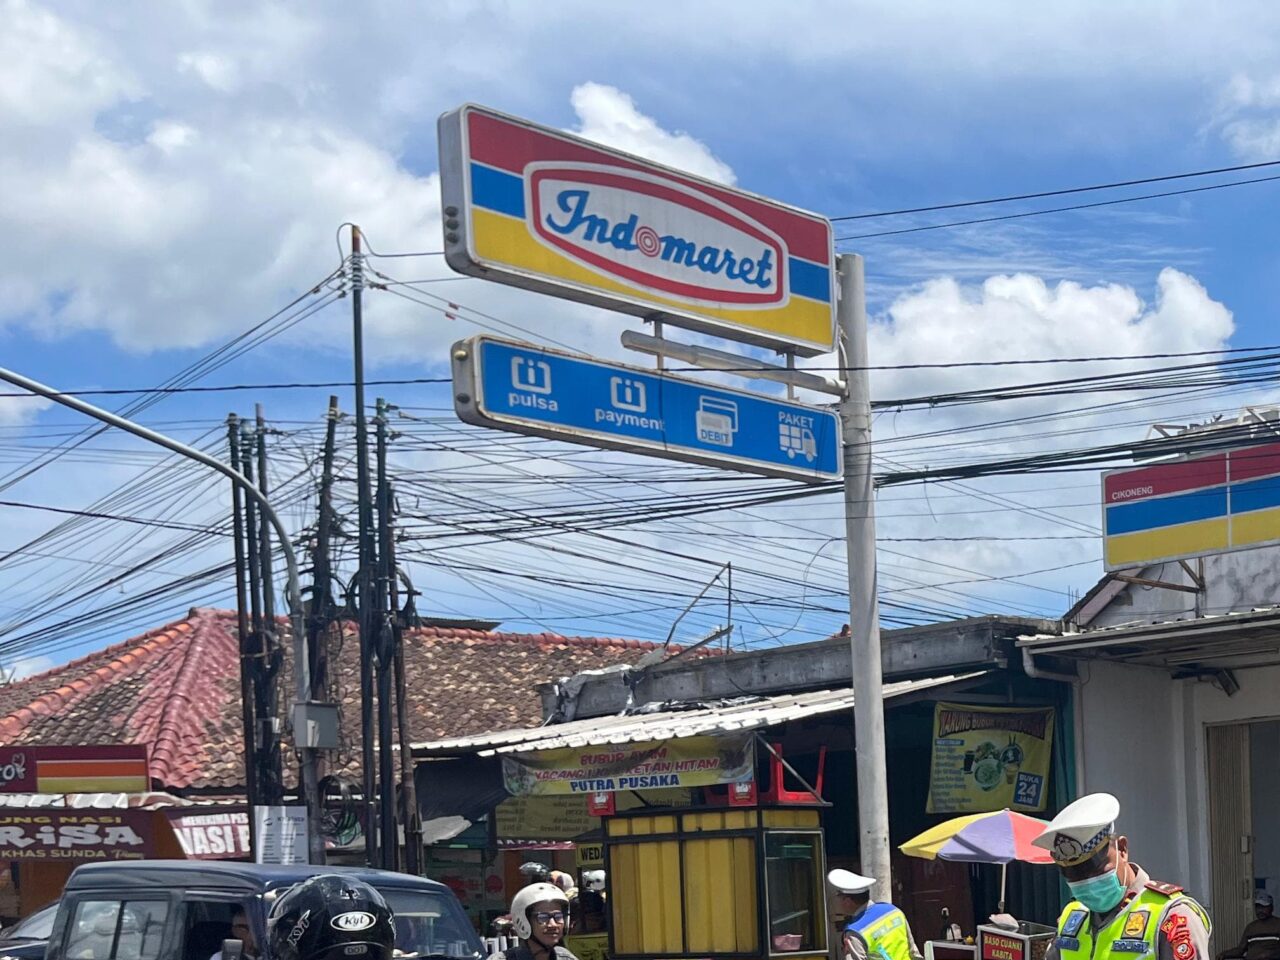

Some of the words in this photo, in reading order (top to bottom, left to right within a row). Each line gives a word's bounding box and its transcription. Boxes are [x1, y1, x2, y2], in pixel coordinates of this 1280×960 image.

[546, 190, 772, 289] Indomaret
[508, 392, 558, 412] pulsa
[595, 407, 665, 431] payment
[778, 411, 815, 428] PAKET
[700, 429, 730, 444] DEBIT
[1112, 486, 1153, 500] CIKONENG
[676, 758, 720, 772] HITAM
[570, 778, 616, 792] PUTRA
[619, 774, 680, 789] PUSAKA
[1017, 781, 1038, 798] 24
[59, 816, 122, 825] NASI
[2, 849, 46, 859] KHAS
[51, 849, 107, 858] SUNDA
[991, 949, 1013, 960] KABITA
